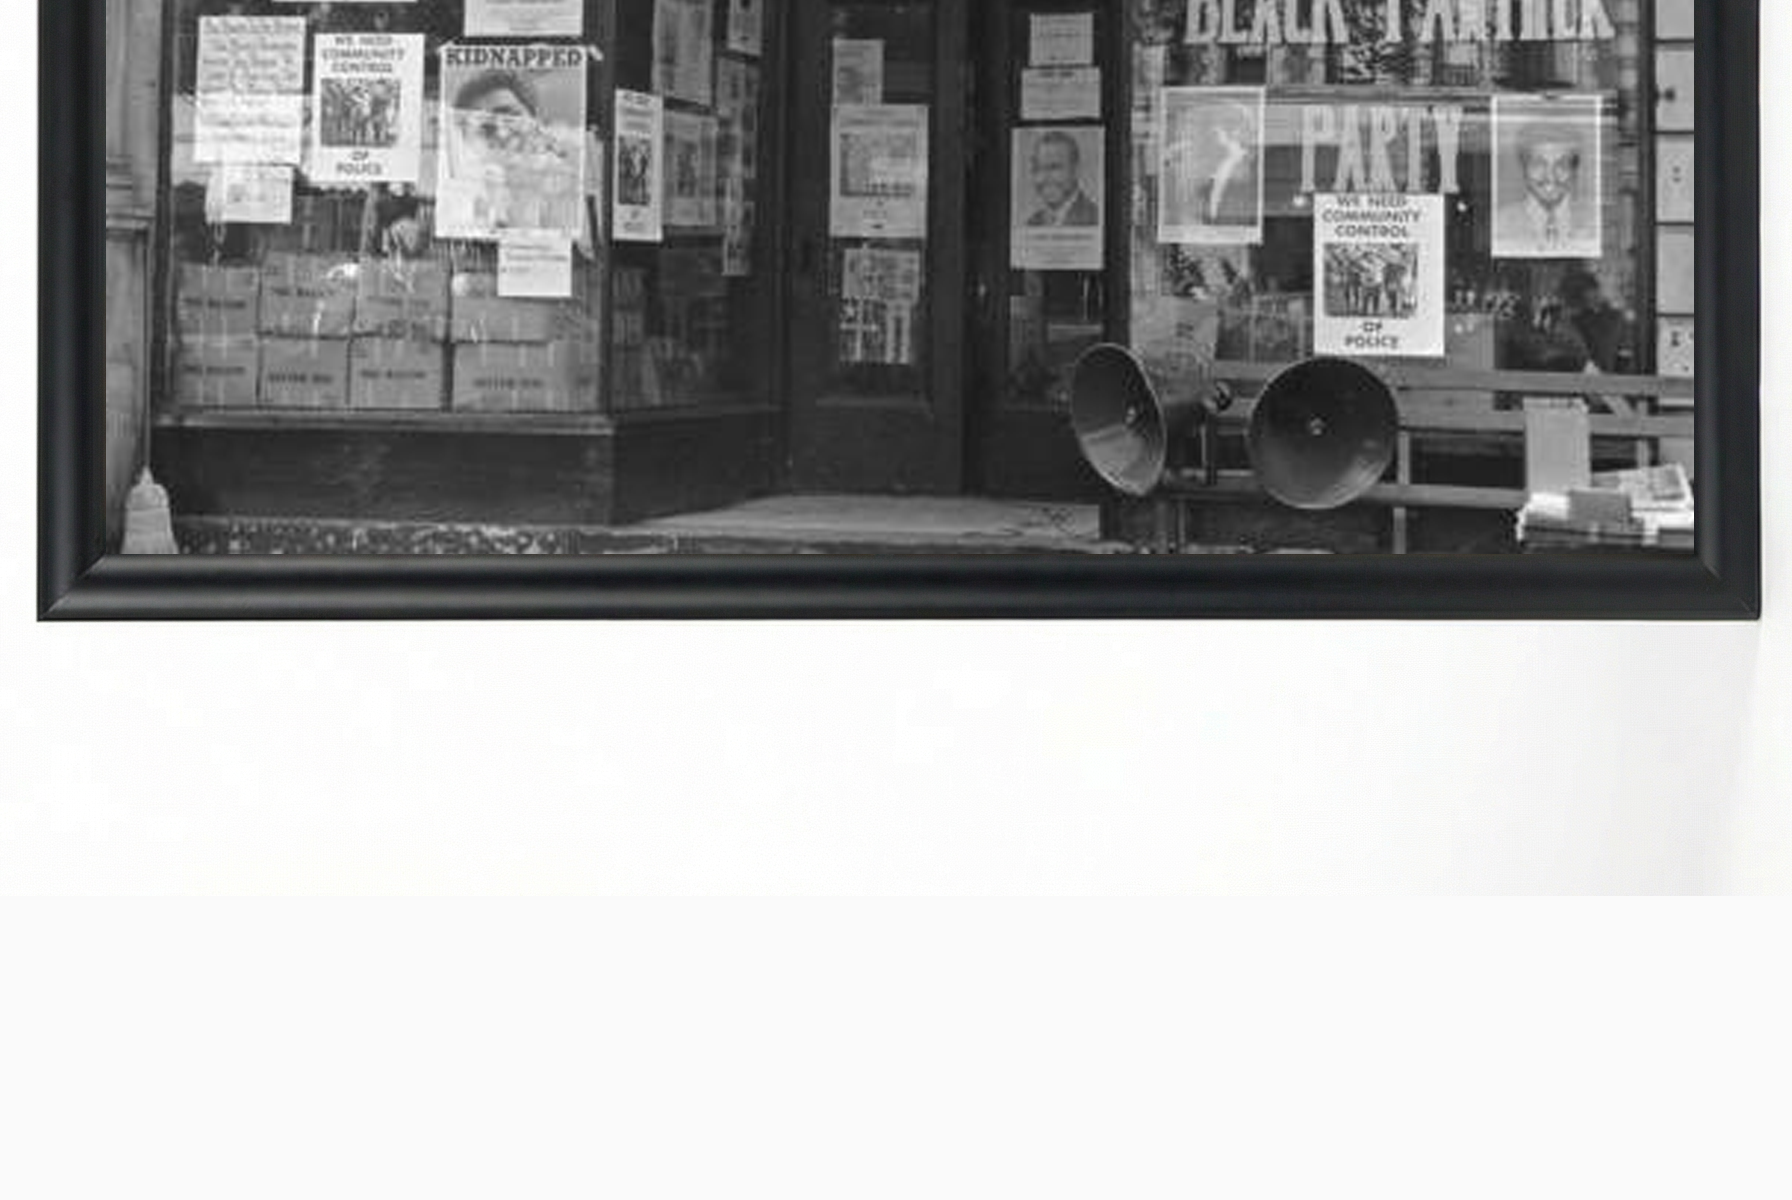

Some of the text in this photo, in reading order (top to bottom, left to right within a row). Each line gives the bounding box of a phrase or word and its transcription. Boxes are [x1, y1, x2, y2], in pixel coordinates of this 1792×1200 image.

[447, 47, 583, 67] KIDNAPPED
[1300, 104, 1461, 193] PARTY
[1322, 208, 1420, 223] COMMUNITY
[1335, 224, 1408, 238] CONTROL
[1344, 334, 1399, 349] POLICE
